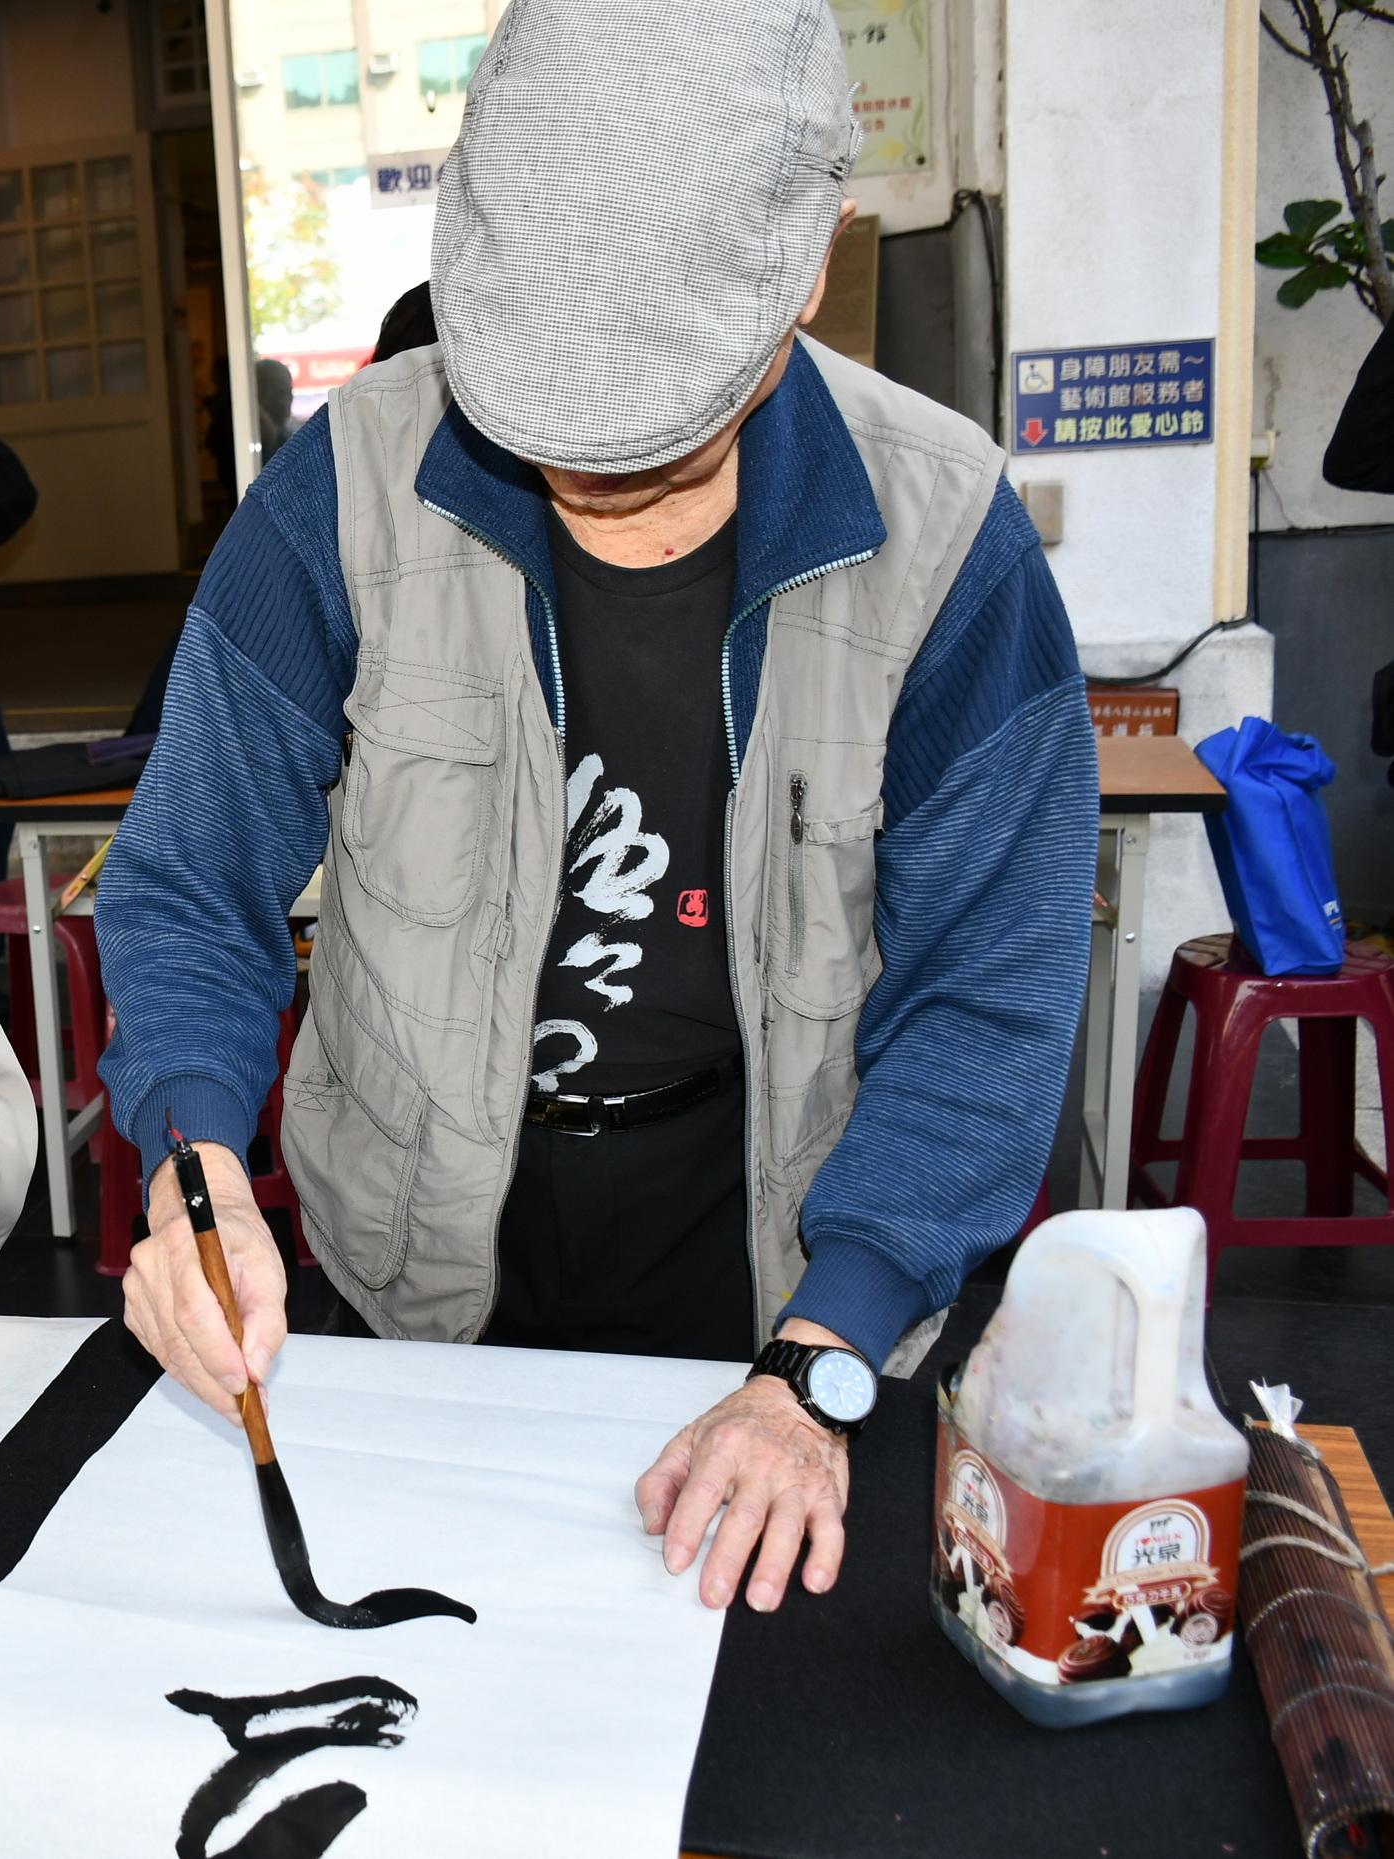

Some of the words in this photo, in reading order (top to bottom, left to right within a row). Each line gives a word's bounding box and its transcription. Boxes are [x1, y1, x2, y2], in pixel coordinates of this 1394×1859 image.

[1060, 378, 1205, 412] 藝術館服務者
[1054, 409, 1205, 443] 請按此愛心鈴
[1132, 1543, 1182, 1565] 光泉
